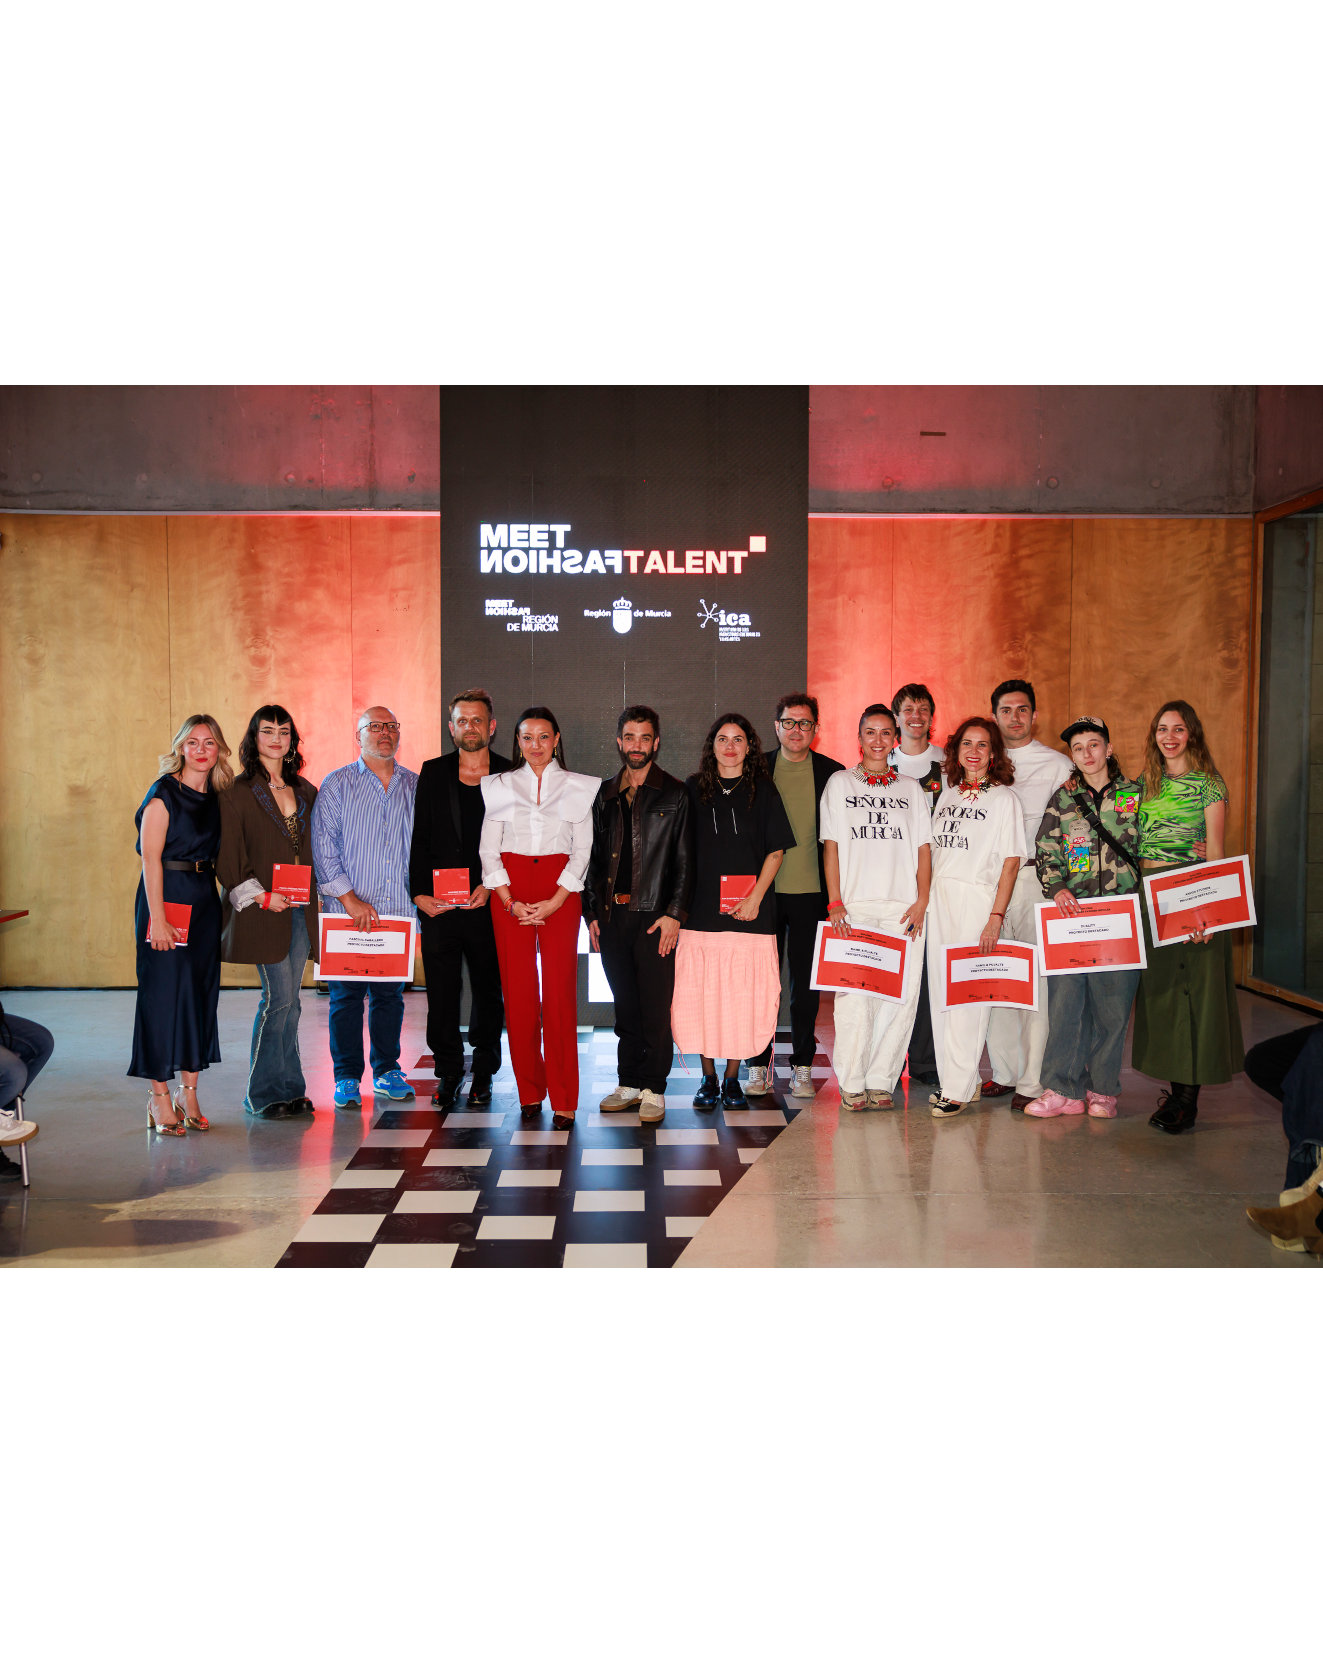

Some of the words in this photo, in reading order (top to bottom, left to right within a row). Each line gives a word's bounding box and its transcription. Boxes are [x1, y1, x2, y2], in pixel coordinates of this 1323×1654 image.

[480, 524, 571, 548] MEET
[623, 550, 748, 574] TALENT
[522, 614, 559, 624] REGIÓN
[633, 609, 644, 618] de
[644, 609, 672, 618] Murcia
[718, 609, 752, 627] ica
[506, 623, 521, 632] DE
[521, 623, 560, 632] MURCIA
[845, 794, 909, 809] SEÑORAS
[867, 811, 889, 825] DE
[942, 820, 961, 834] DE
